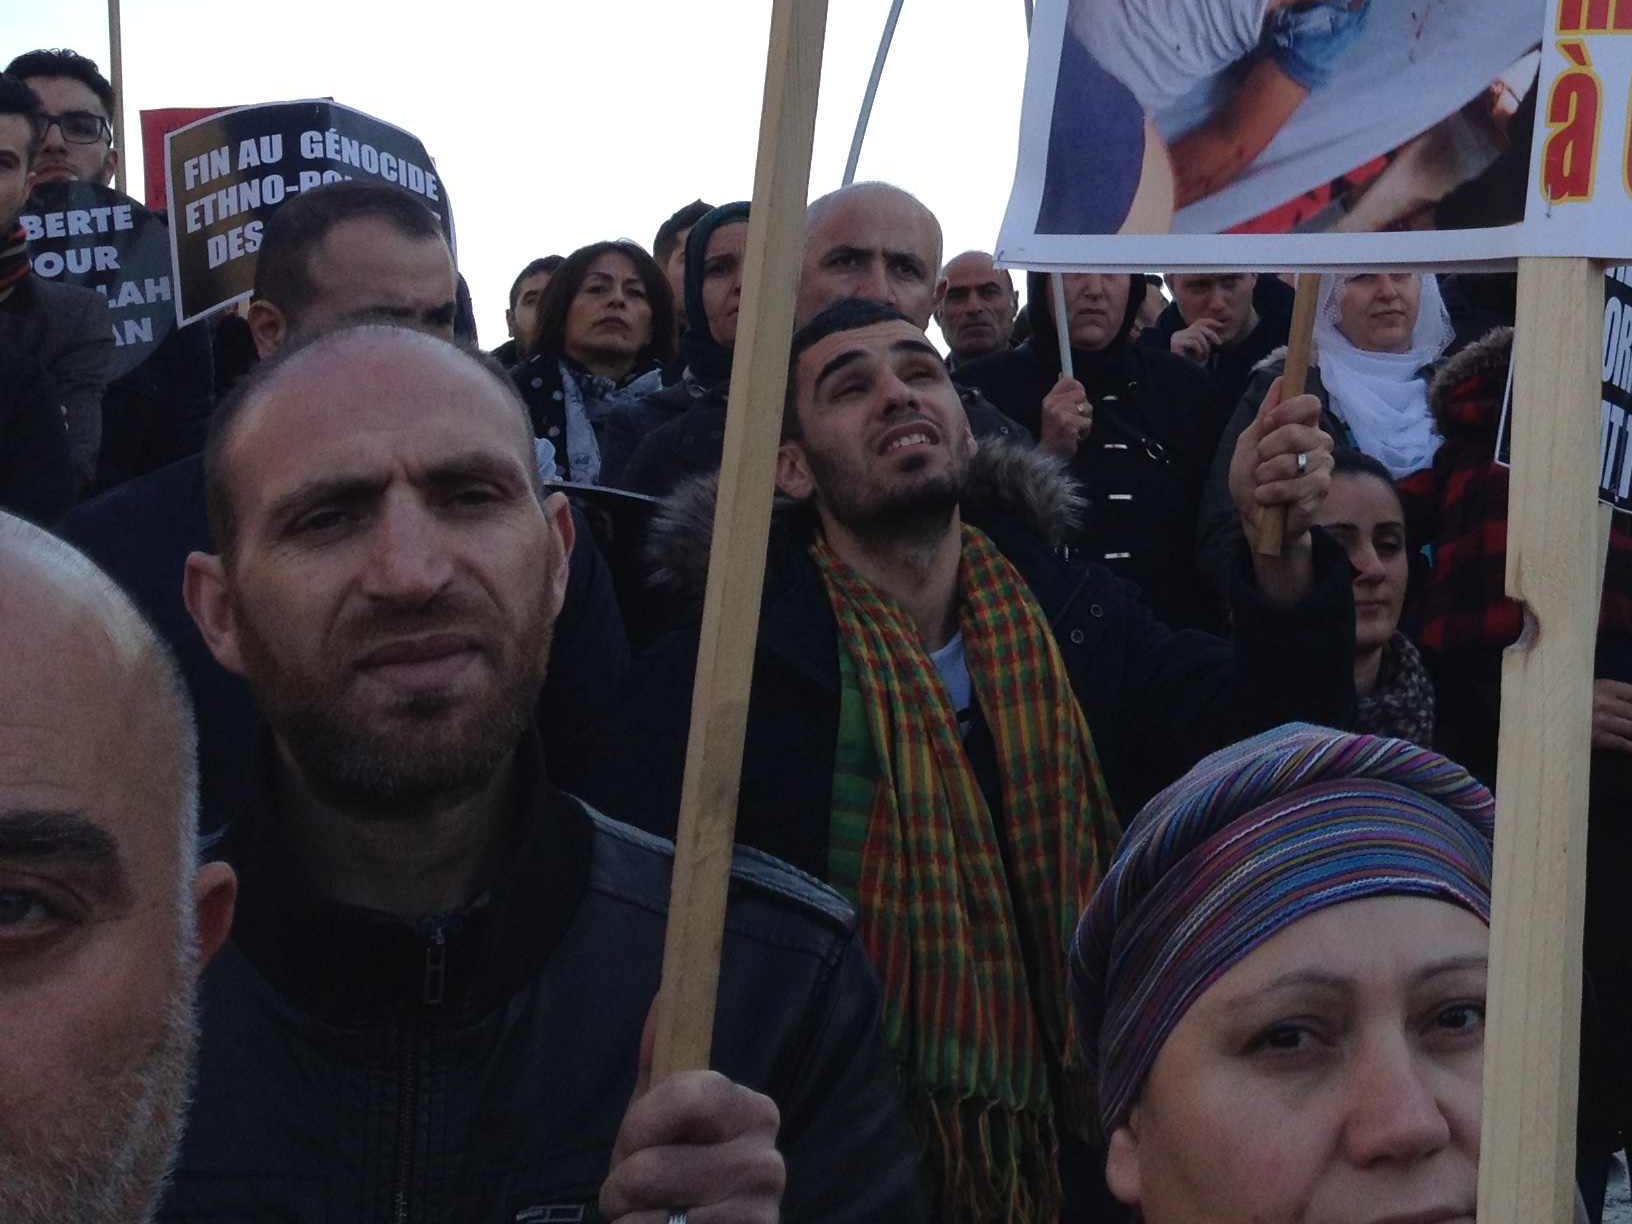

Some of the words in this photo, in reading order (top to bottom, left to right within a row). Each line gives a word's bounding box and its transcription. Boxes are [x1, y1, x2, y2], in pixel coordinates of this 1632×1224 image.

[1540, 37, 1599, 204] à
[184, 145, 230, 191] FIN
[237, 134, 283, 171] AU
[300, 128, 439, 202] GÉNOCIDE
[19, 204, 133, 241] BERTE
[207, 220, 264, 269] DES
[29, 245, 121, 277] OUR
